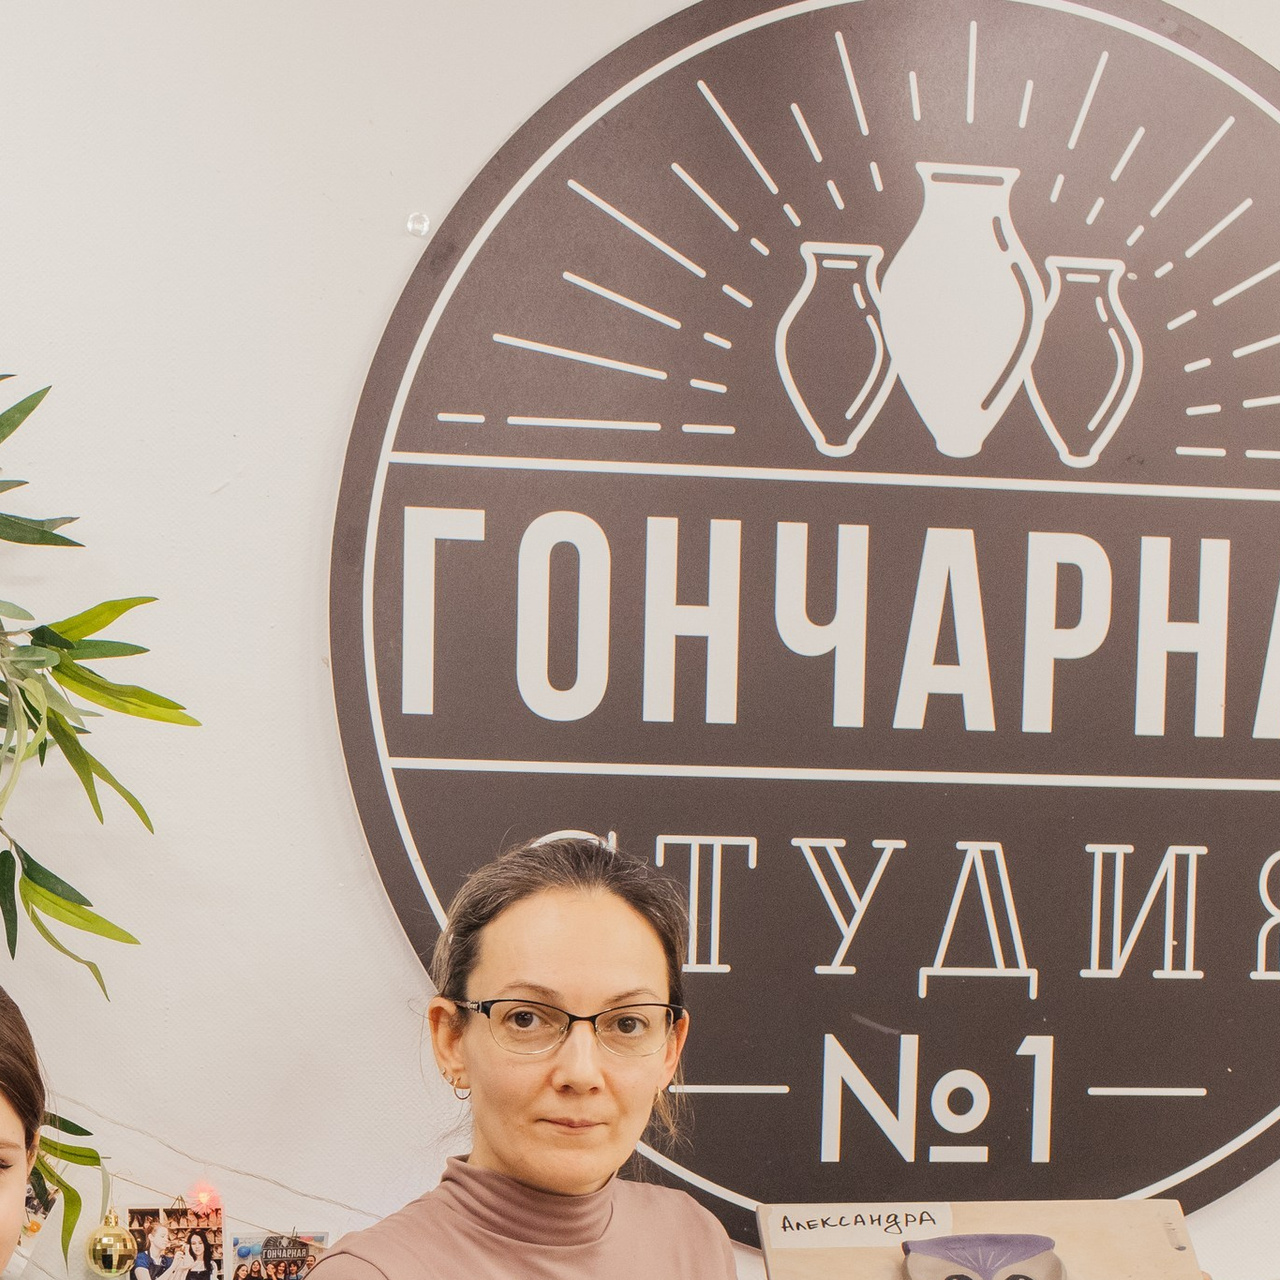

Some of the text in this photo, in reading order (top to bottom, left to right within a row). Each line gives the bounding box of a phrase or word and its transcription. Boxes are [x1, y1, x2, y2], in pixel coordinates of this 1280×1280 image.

[401, 506, 1280, 738] ГОНЧАРН
[531, 830, 1280, 999] ТУДИ
[820, 1033, 1055, 1164] №1
[262, 1248, 307, 1259] ГОНЧАРНАЯ
